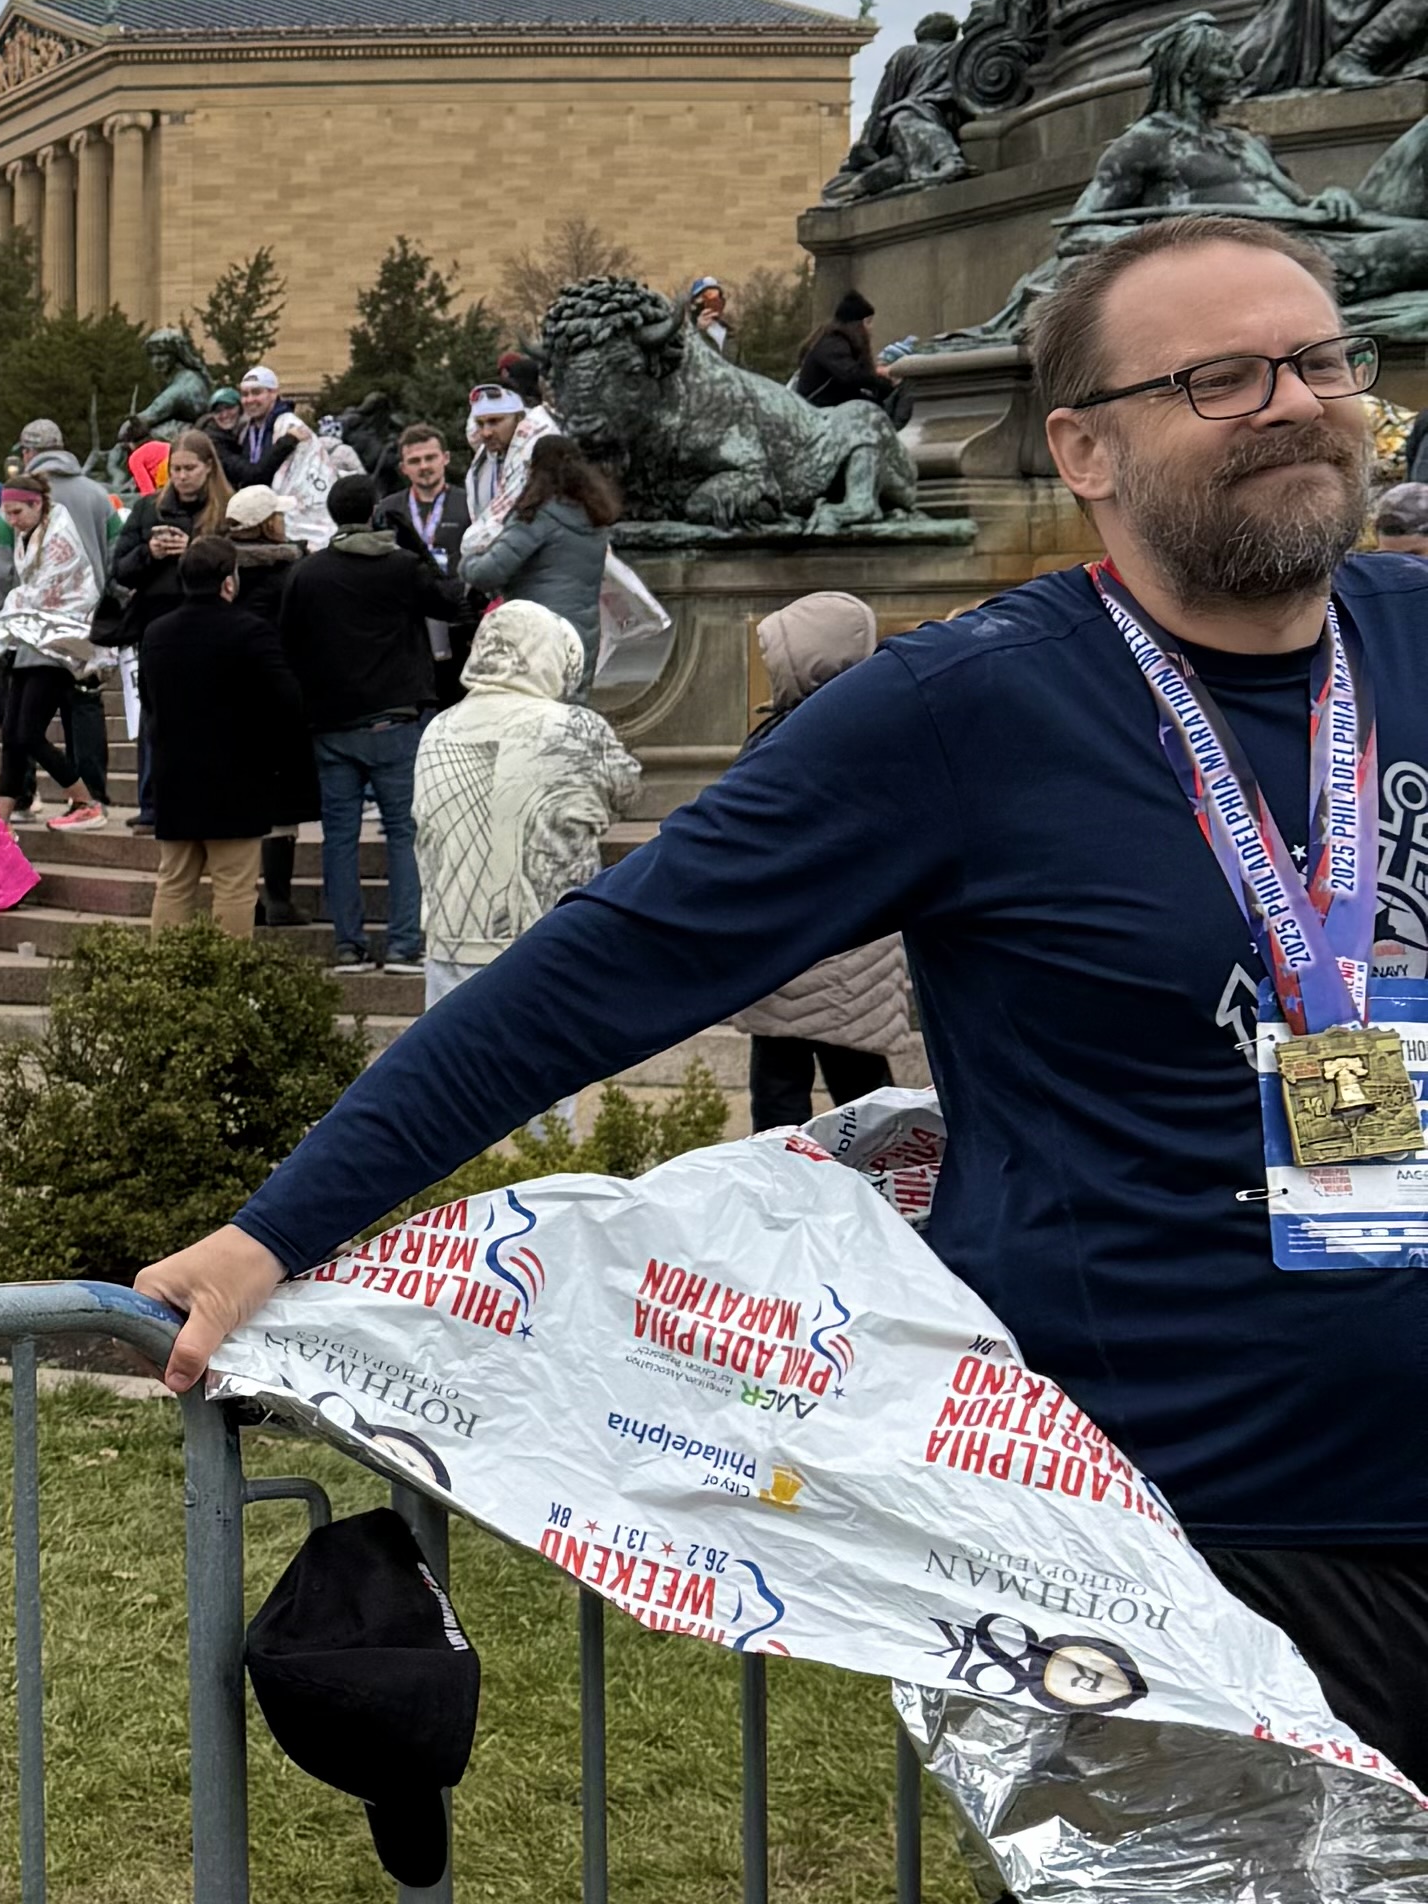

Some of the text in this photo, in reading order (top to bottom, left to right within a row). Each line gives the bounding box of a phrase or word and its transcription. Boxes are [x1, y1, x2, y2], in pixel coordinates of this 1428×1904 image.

[1152, 669, 1225, 773] MARATHON
[1332, 699, 1357, 838] PHILADELPHIA
[1210, 774, 1290, 918] PHILADELPHIA
[1331, 845, 1356, 891] 2025
[1274, 918, 1312, 968] 2025
[347, 1227, 479, 1273] MARAT
[638, 1258, 803, 1341] MARATHON
[264, 1331, 482, 1439] ROTHMAN
[295, 1330, 459, 1400] ORTHOPAEDICS
[634, 1299, 833, 1397] PHILADELPHIA
[607, 1412, 758, 1480] Philadelphia
[701, 1473, 750, 1498] City of
[925, 1429, 1180, 1540] HILADELPHIA
[540, 1528, 716, 1620] WEEKEND
[547, 1502, 730, 1574] 26.2 13.1 8K
[925, 1548, 1175, 1632] ROTHMAN
